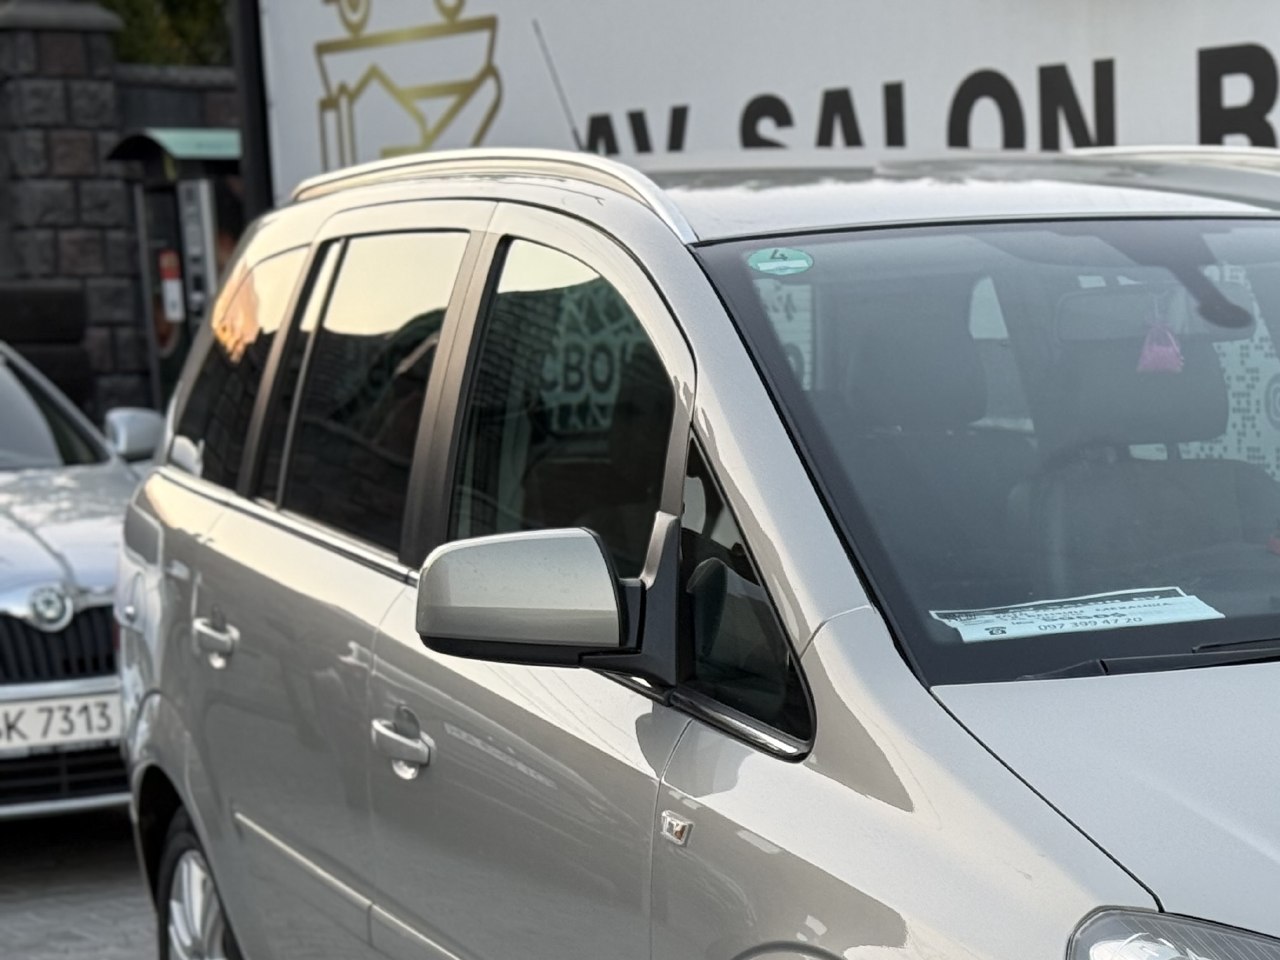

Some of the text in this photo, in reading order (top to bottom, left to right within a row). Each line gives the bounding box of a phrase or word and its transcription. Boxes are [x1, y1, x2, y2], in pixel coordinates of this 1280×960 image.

[1038, 623, 1065, 631] 097
[0, 701, 112, 743] K 7313
